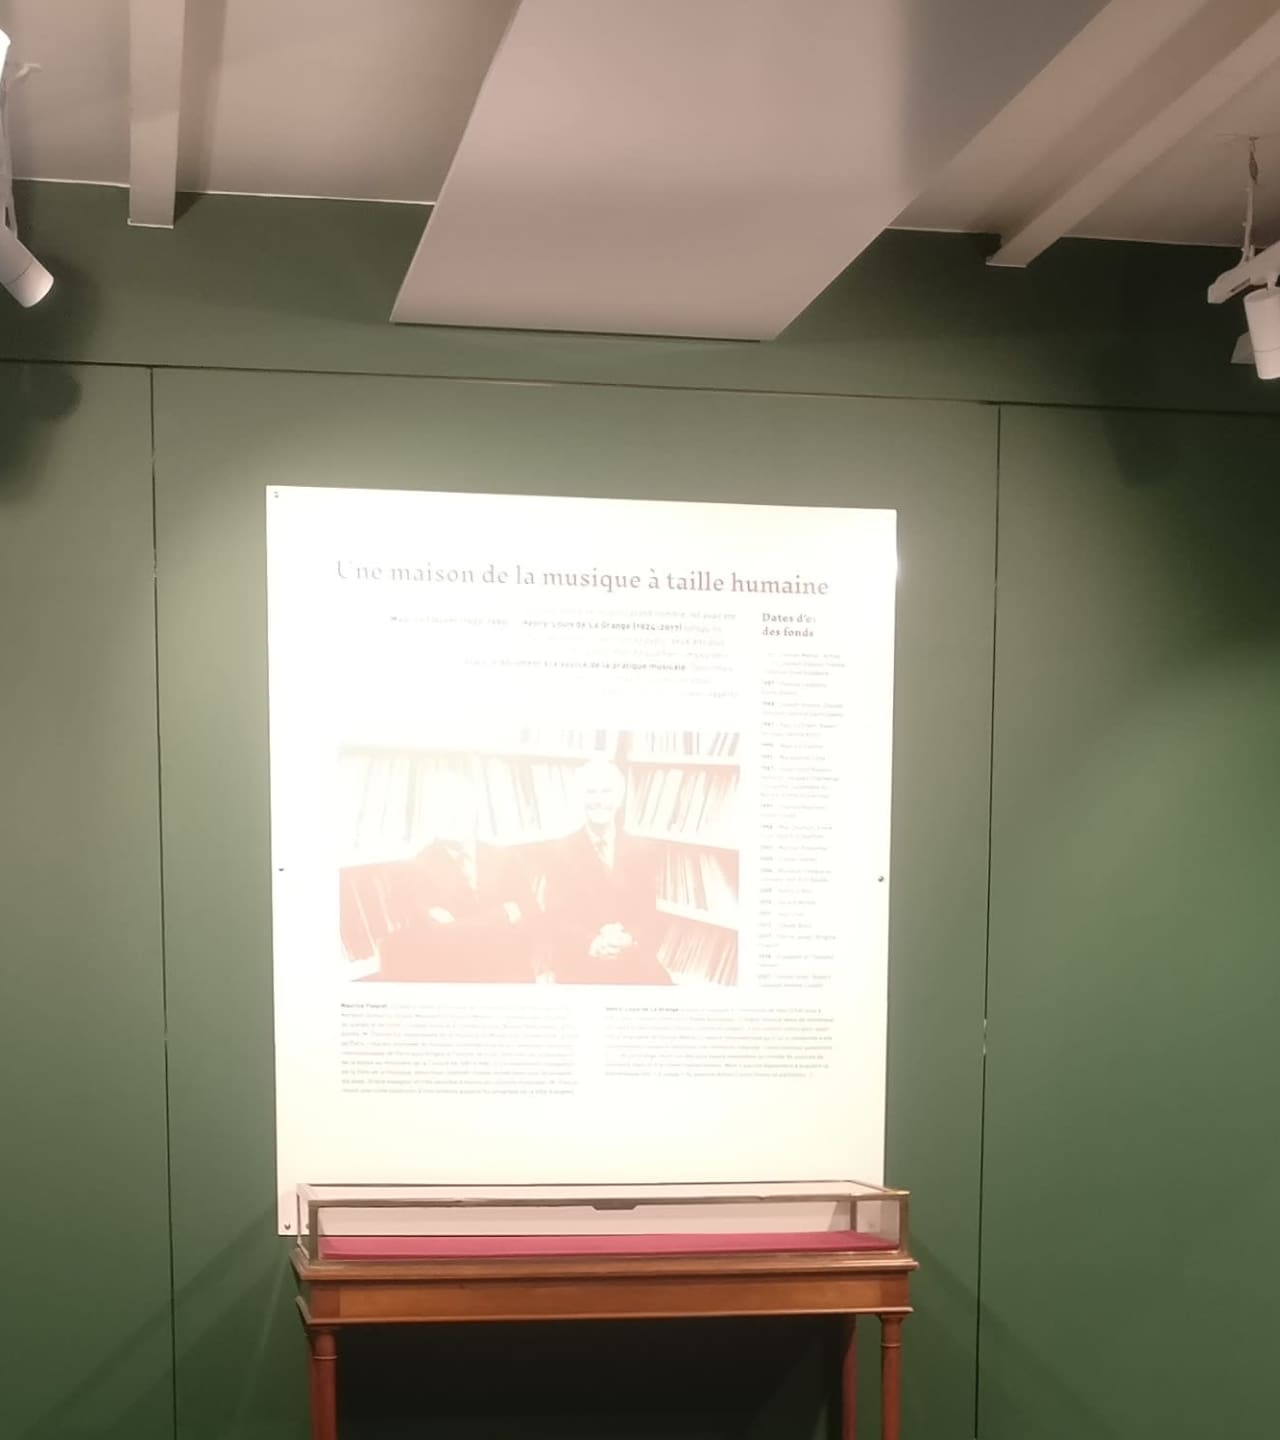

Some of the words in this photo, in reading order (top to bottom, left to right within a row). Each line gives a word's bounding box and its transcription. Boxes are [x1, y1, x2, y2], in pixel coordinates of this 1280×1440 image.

[389, 561, 474, 583] maison
[481, 563, 509, 585] de
[515, 564, 536, 586] la
[543, 567, 642, 593] musique
[648, 568, 661, 590] à
[666, 569, 725, 592] taille
[731, 572, 830, 596] humaine
[761, 612, 794, 623] Dates
[760, 626, 781, 637] des
[782, 626, 815, 638] fonds
